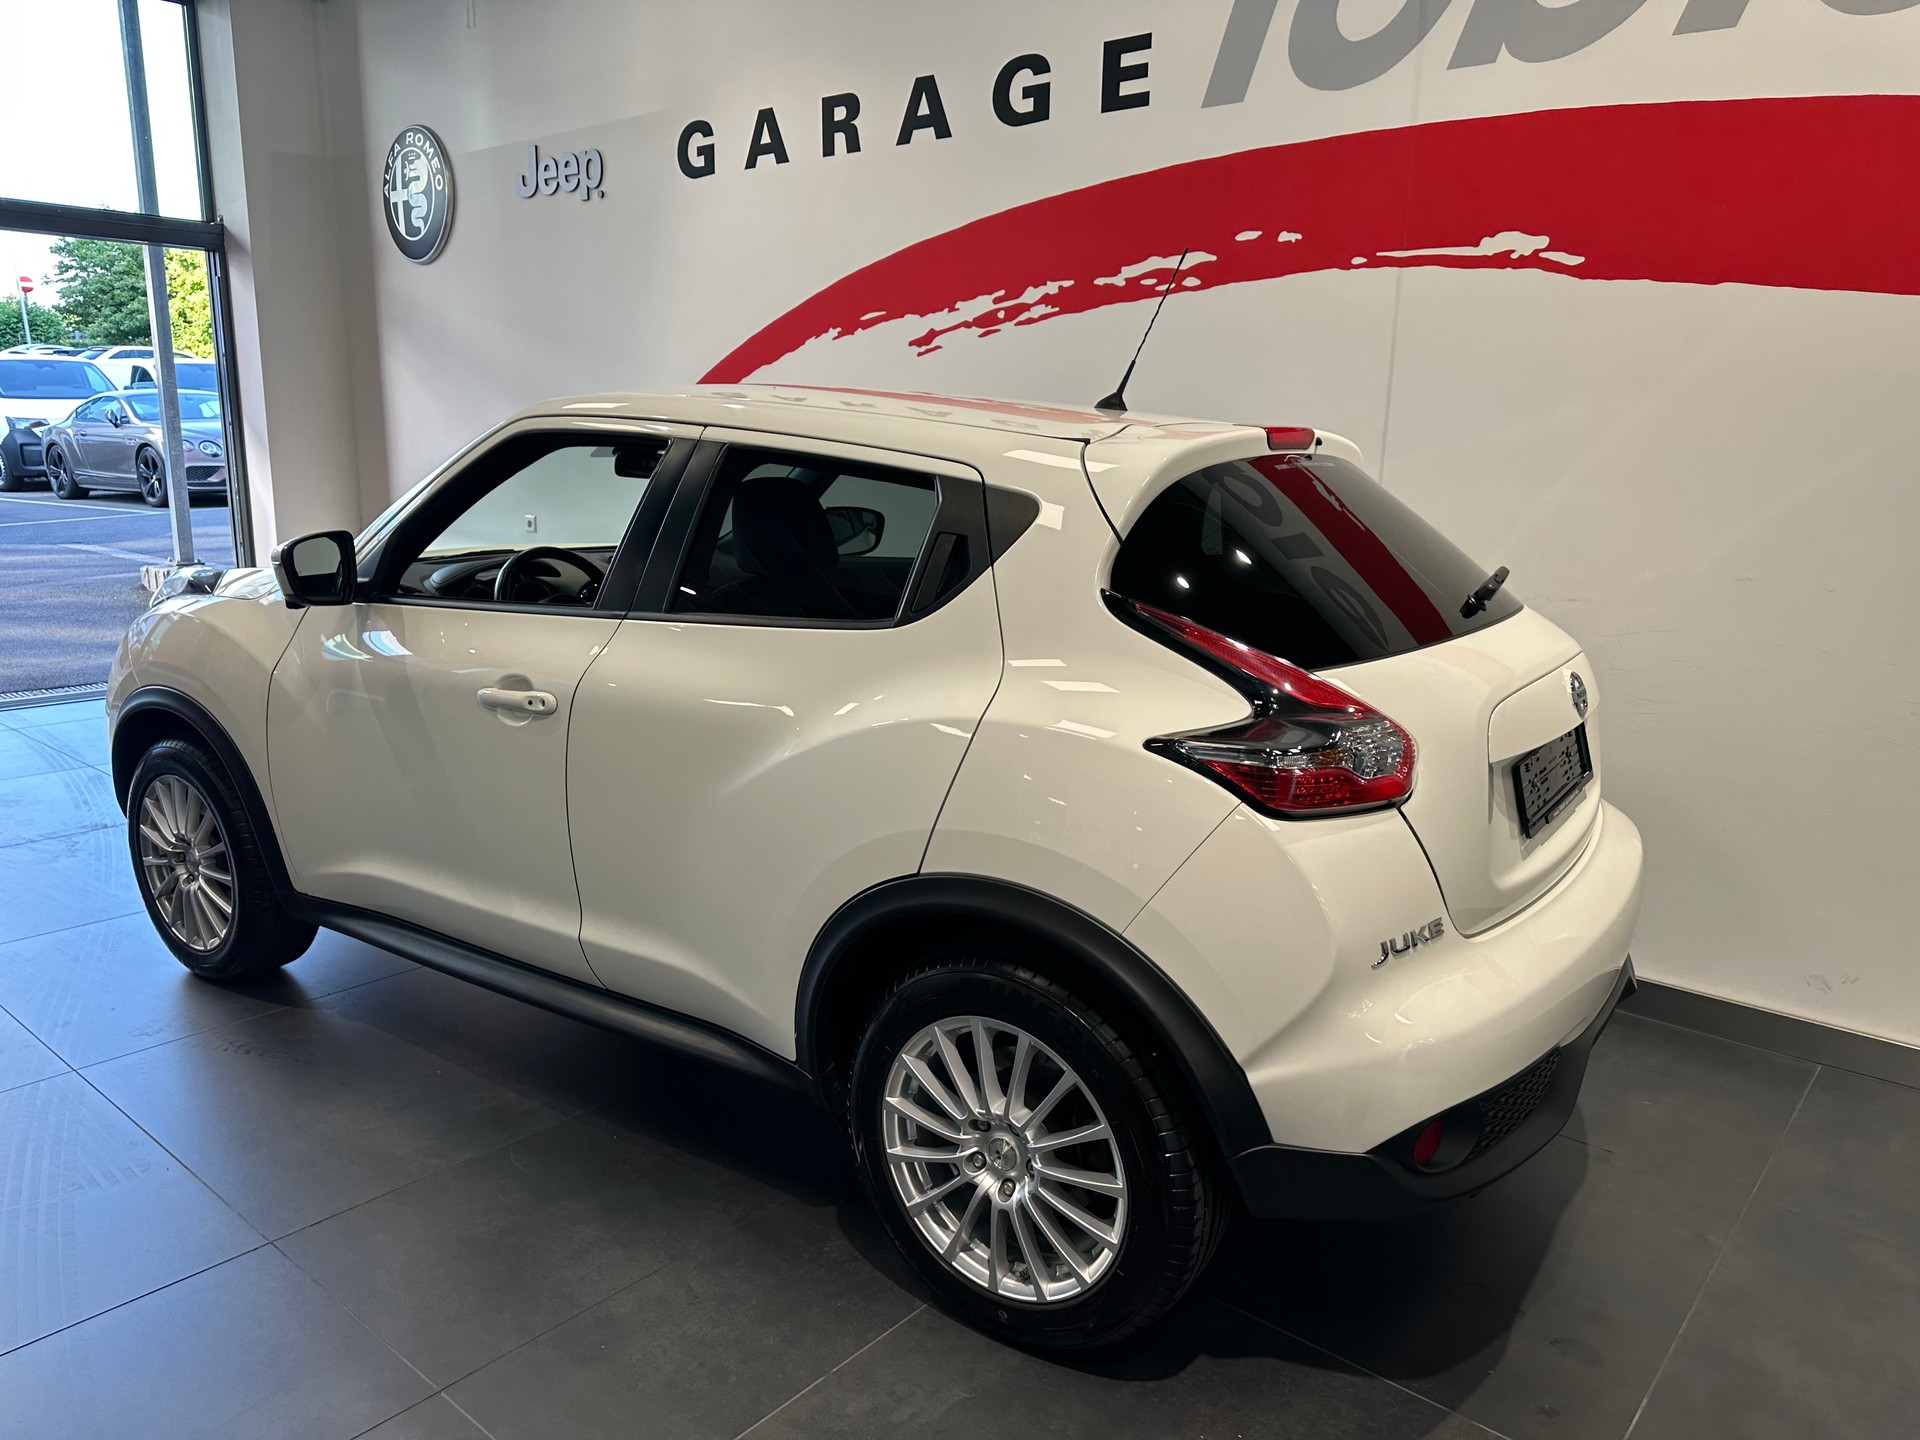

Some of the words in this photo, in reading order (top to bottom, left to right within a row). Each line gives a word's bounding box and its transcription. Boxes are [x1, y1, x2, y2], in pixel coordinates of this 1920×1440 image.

[677, 32, 1153, 180] GARAGE
[383, 142, 401, 198] ALFA
[406, 131, 444, 191] ROMEO
[516, 144, 604, 201] Jeep
[1371, 916, 1445, 970] JUKE
